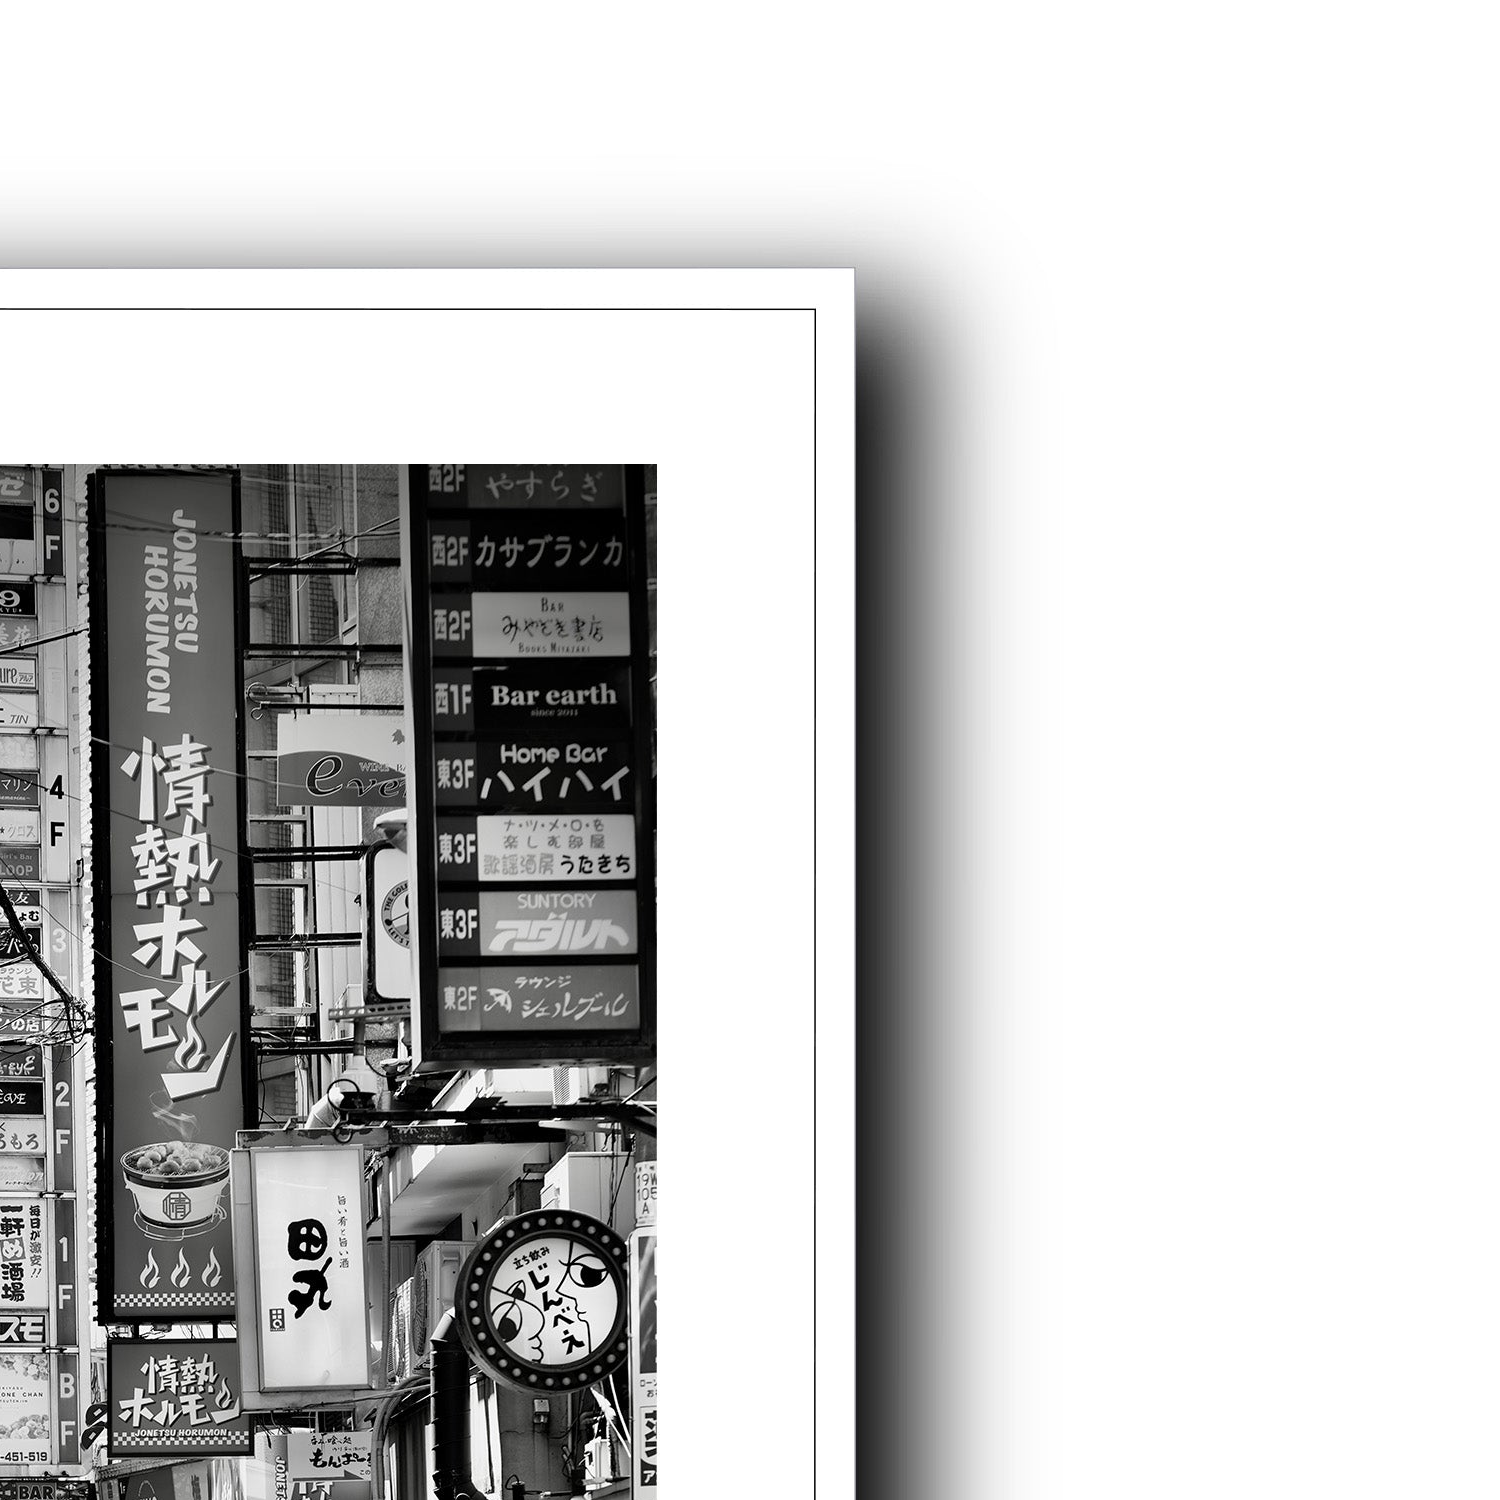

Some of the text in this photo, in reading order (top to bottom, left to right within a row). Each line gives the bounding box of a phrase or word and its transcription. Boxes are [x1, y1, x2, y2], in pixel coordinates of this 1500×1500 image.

[484, 469, 604, 502] やすらぎ
[44, 488, 61, 560] 6F
[431, 534, 469, 567] 西2F
[474, 534, 624, 569] カサブランカ
[171, 508, 199, 654] JONETSU
[144, 544, 171, 715] HORUMON
[433, 608, 472, 642] 西2F
[434, 682, 473, 716] 西1F
[490, 682, 619, 707] Bar earth
[500, 743, 609, 765] Home Bar
[436, 758, 475, 790] 東3F
[480, 766, 631, 802] ハイハイ
[49, 774, 66, 847] 4F
[438, 832, 477, 865] 東3F
[560, 853, 632, 876] うたきち
[0, 864, 34, 876] LOOP
[118, 732, 238, 1102] 情熱ホルモン
[517, 892, 597, 910] SUNTORY
[440, 907, 478, 940] 東3F
[514, 974, 573, 989] ラウンジ
[443, 985, 478, 1012] 東2F
[54, 1081, 71, 1155] 2F
[642, 1201, 650, 1214] A
[0, 1205, 26, 1303] 一軒め酒場
[511, 1246, 551, 1271] 立ち飲み
[58, 1236, 74, 1310] 1F
[140, 1353, 219, 1395] 情熱
[134, 1428, 228, 1438] JONETSU HORUMON
[17, 1484, 56, 1500] BAR
